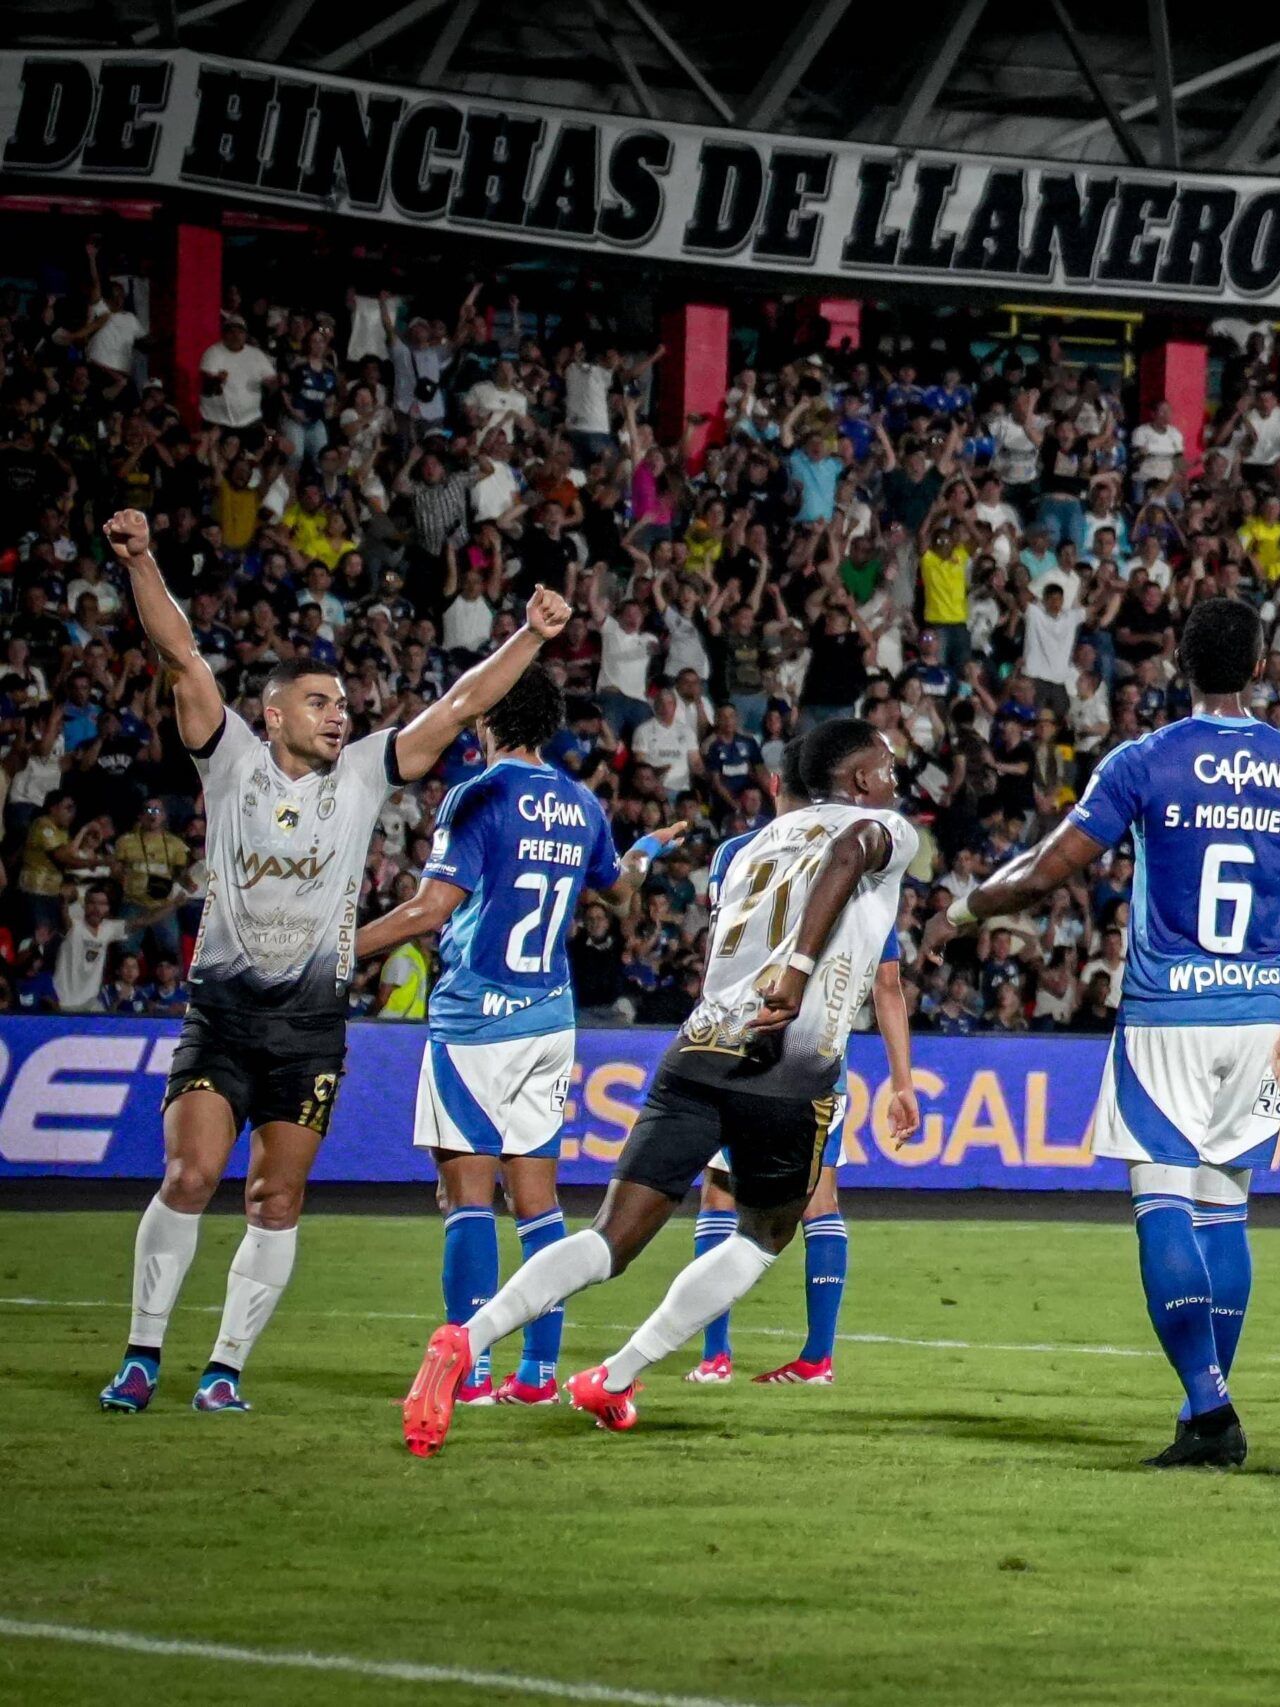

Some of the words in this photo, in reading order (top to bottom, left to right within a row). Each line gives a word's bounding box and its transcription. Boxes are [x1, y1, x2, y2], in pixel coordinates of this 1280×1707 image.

[2, 56, 173, 174] DE
[180, 68, 676, 248] HINCHAS
[683, 137, 835, 266] DE
[518, 839, 582, 867] PEEIRA
[1198, 843, 1254, 954] 6
[505, 872, 574, 973] 21
